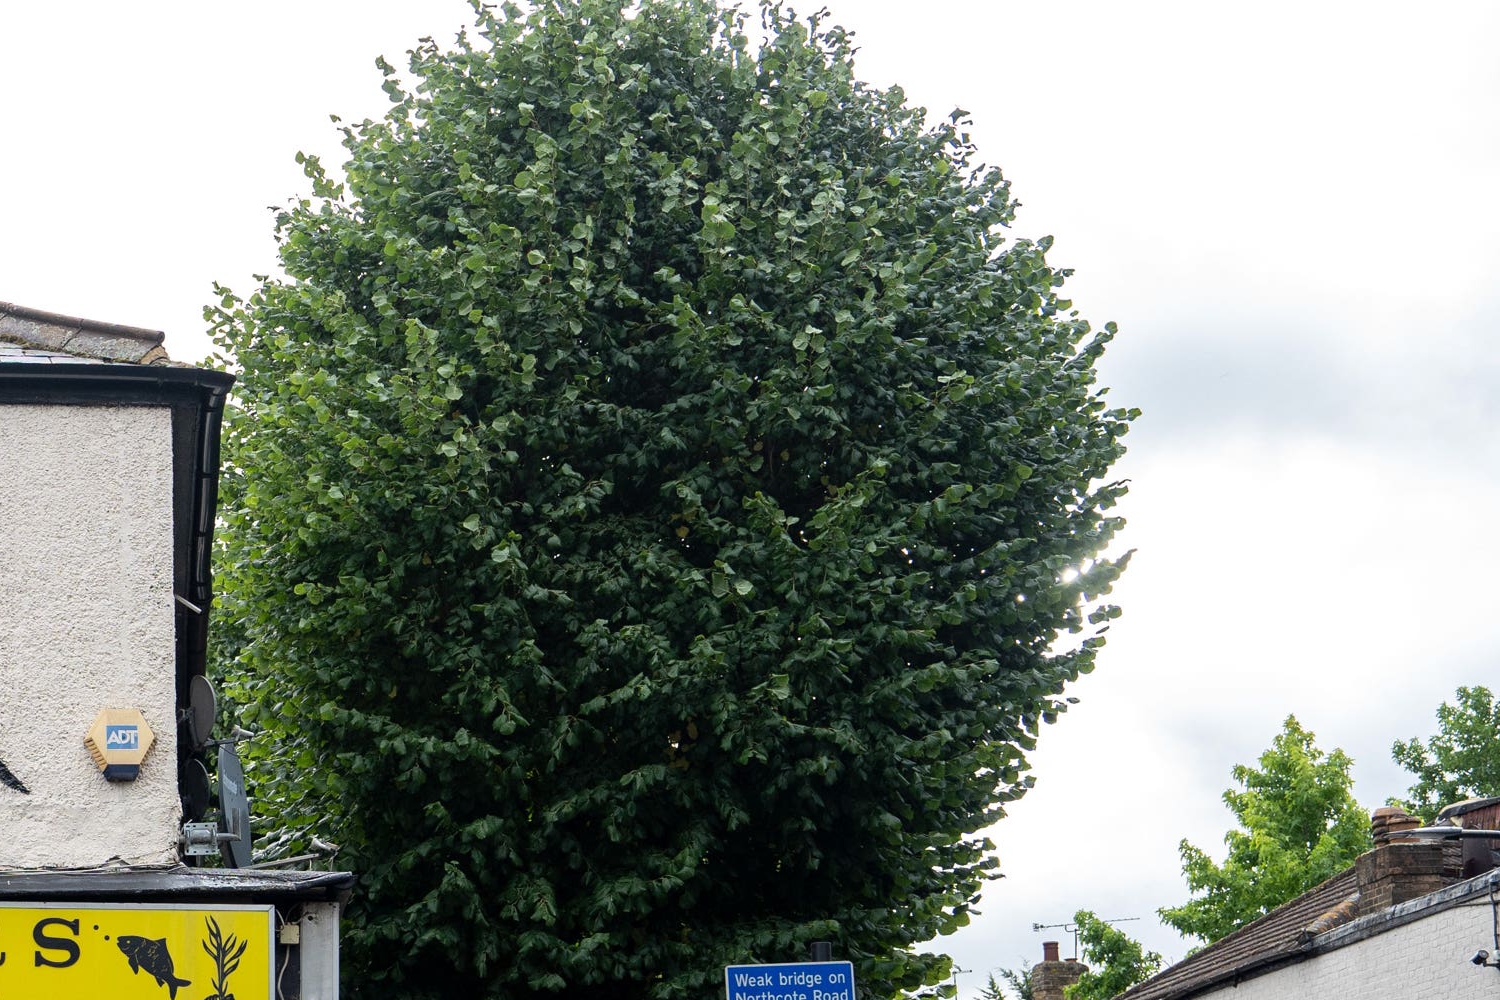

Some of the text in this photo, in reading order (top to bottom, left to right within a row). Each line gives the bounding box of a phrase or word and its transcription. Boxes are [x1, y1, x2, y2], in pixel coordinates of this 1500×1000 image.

[107, 730, 138, 745] ADT
[735, 972, 845, 987] Weak bridge on
